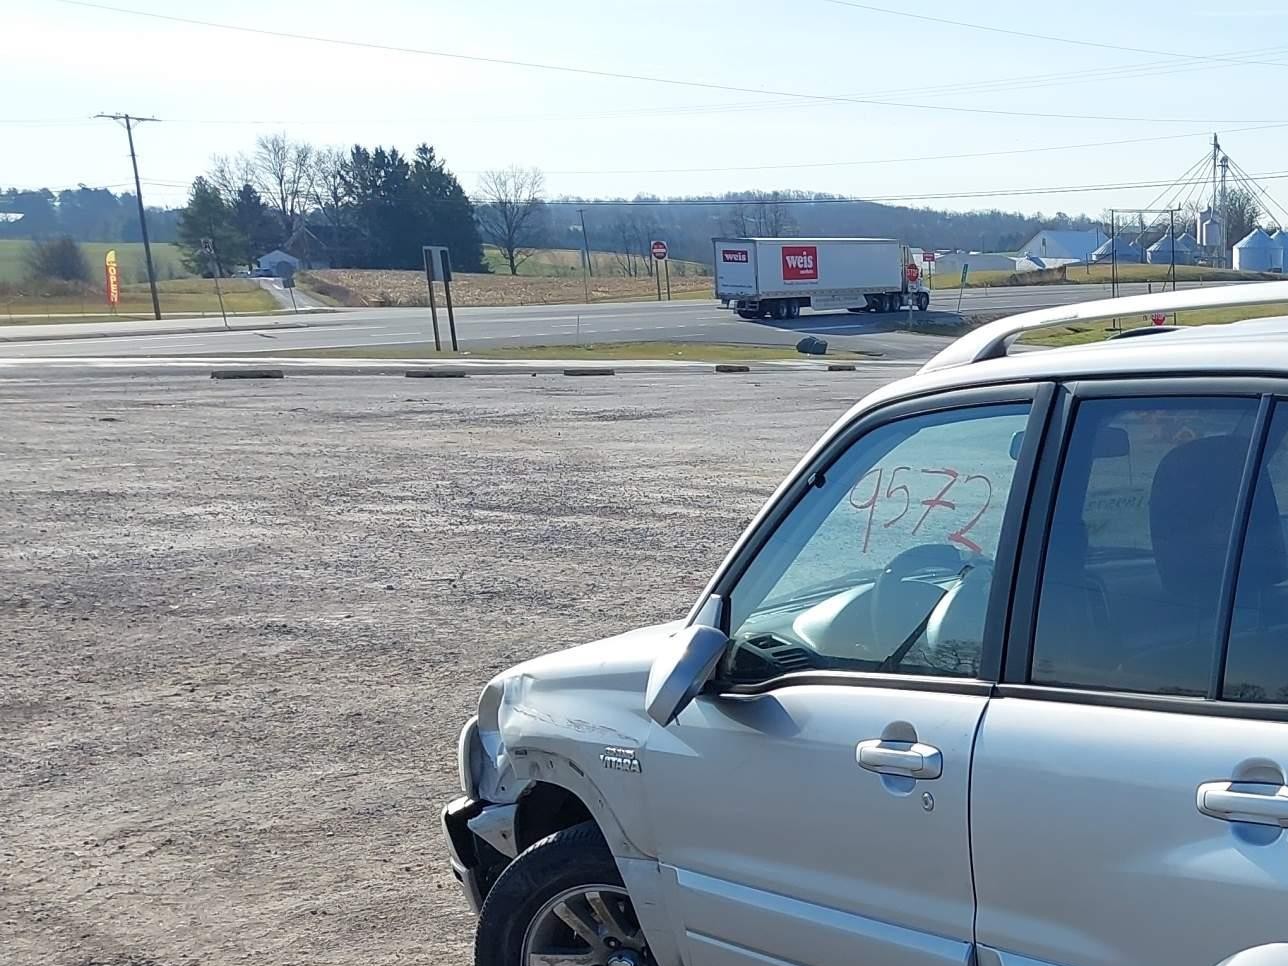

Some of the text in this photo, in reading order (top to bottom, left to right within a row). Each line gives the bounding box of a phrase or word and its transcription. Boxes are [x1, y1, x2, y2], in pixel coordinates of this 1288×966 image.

[724, 252, 747, 261] weis
[786, 251, 813, 269] weis
[907, 269, 918, 277] STOP
[850, 466, 992, 554] 9572
